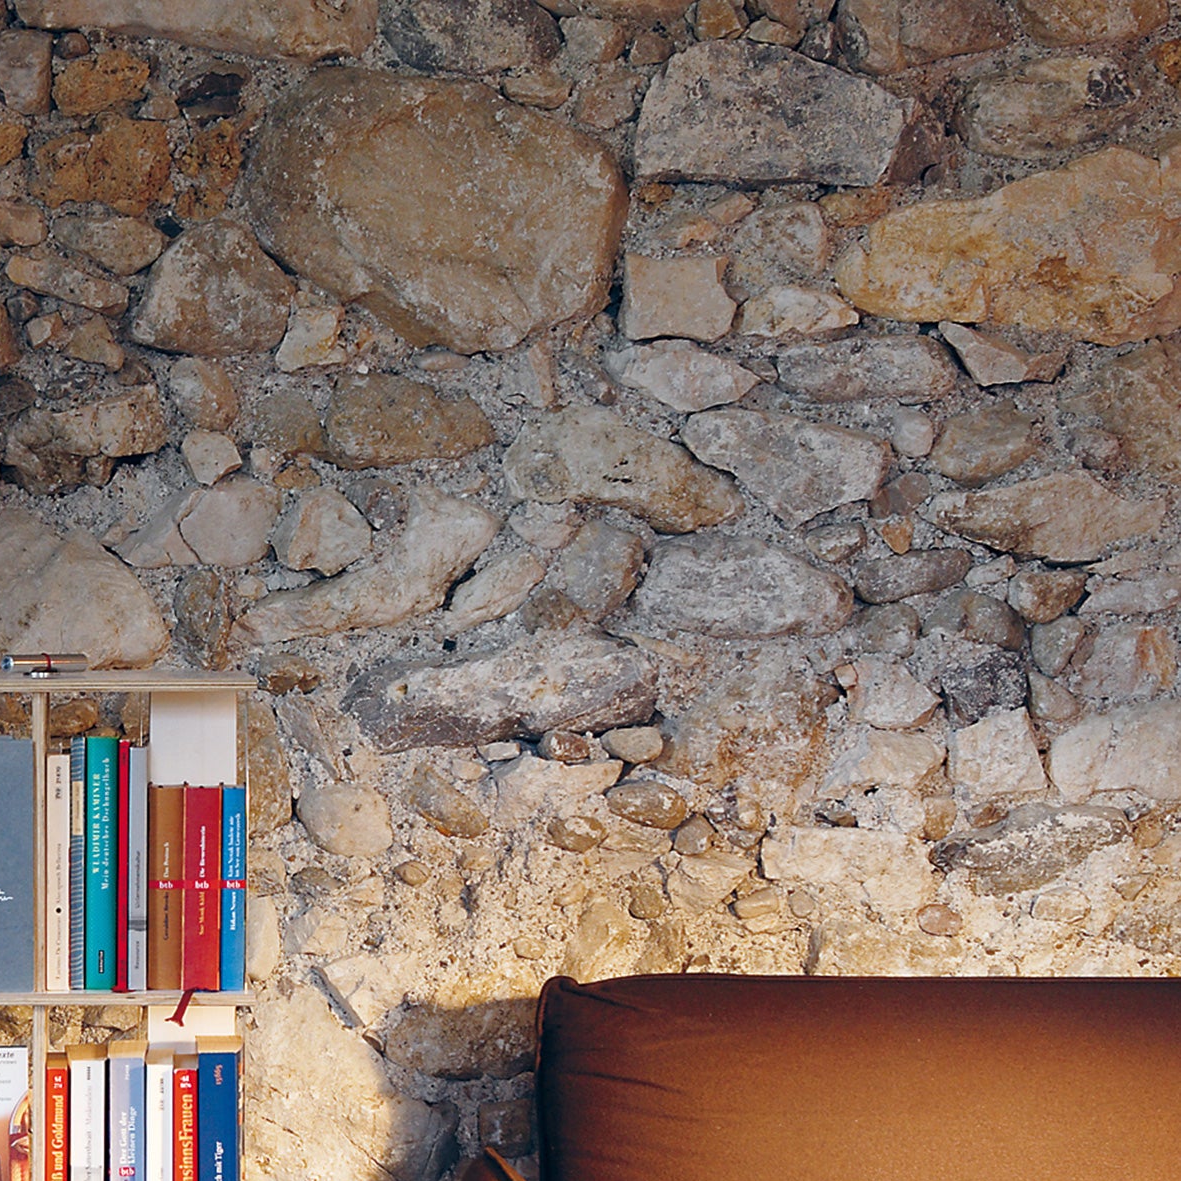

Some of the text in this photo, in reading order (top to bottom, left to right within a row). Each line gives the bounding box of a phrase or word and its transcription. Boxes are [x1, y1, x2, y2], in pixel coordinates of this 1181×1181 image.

[92, 773, 100, 873] WLADIMIR KAMINER
[101, 757, 111, 890] Mein deutsches Dschungelbuch
[159, 881, 174, 889] btb
[195, 881, 210, 889] btb
[226, 881, 240, 889] btb
[51, 1095, 63, 1149] Goldmund
[128, 1106, 137, 1132] Dinge
[119, 1111, 127, 1165] Der Gott der
[51, 1151, 63, 1171] und
[214, 1141, 224, 1161] Tiger
[119, 1167, 135, 1176] btb
[214, 1161, 223, 1174] mit
